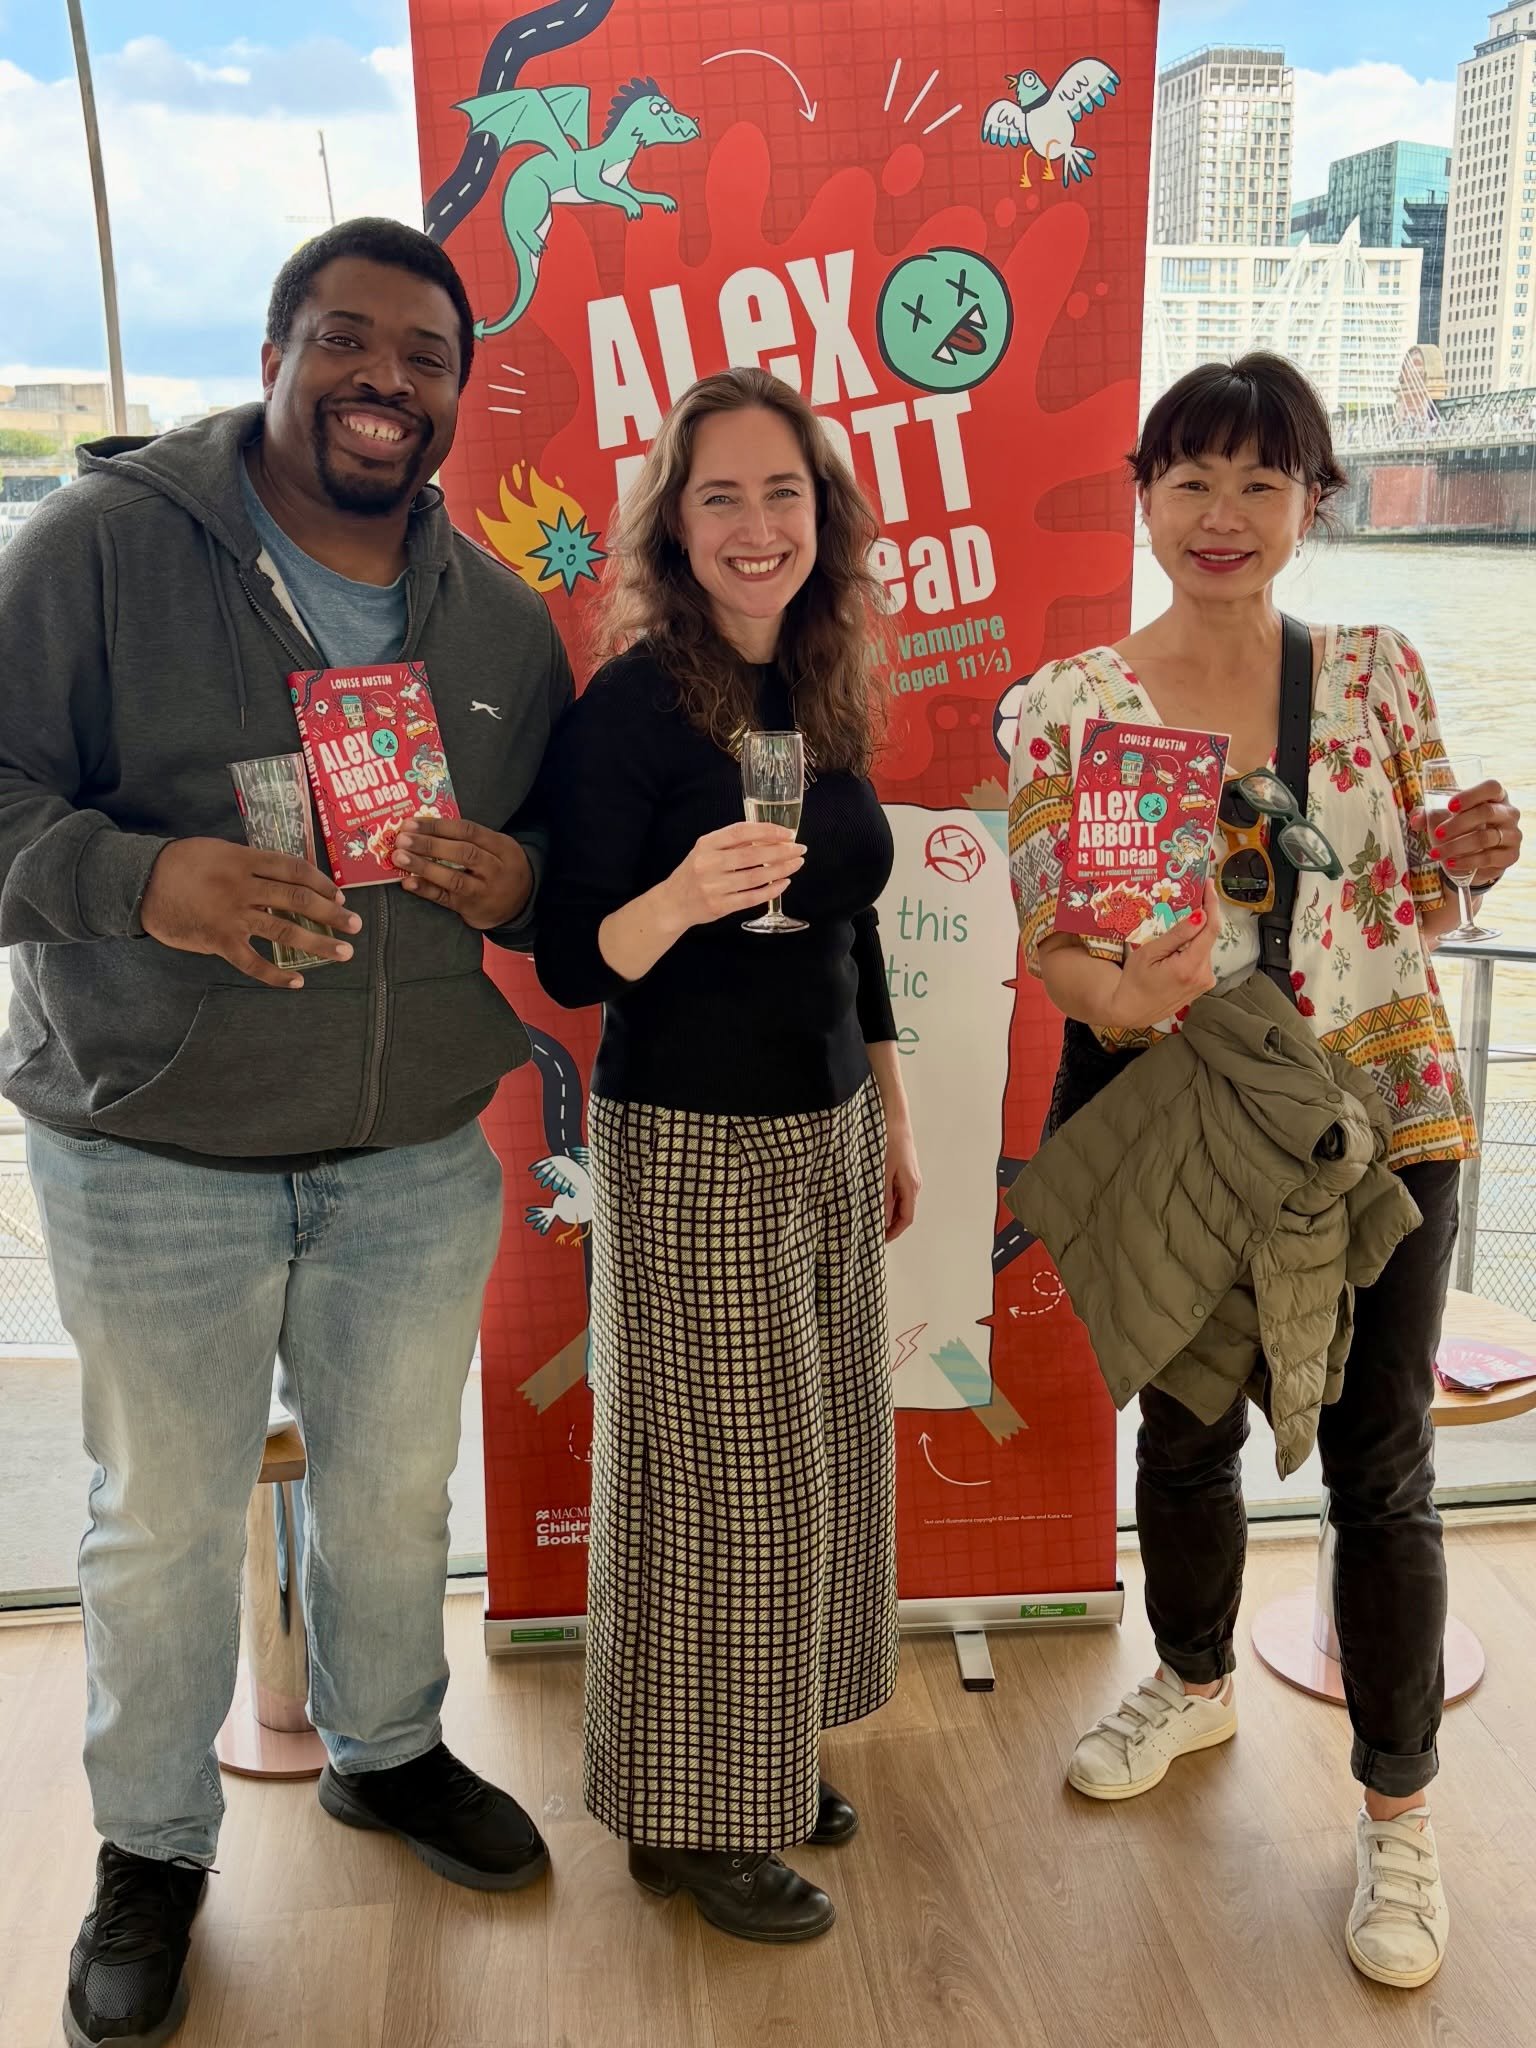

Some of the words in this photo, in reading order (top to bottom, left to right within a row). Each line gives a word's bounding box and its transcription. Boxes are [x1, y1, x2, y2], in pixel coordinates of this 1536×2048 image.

[898, 615, 1006, 660] vampire
[889, 660, 949, 696] (aged
[329, 757, 400, 798] ABBOTT
[1078, 822, 1158, 848] ABBOTT
[897, 896, 968, 943] this
[536, 1520, 590, 1534] Childr
[537, 1532, 590, 1547] Books
